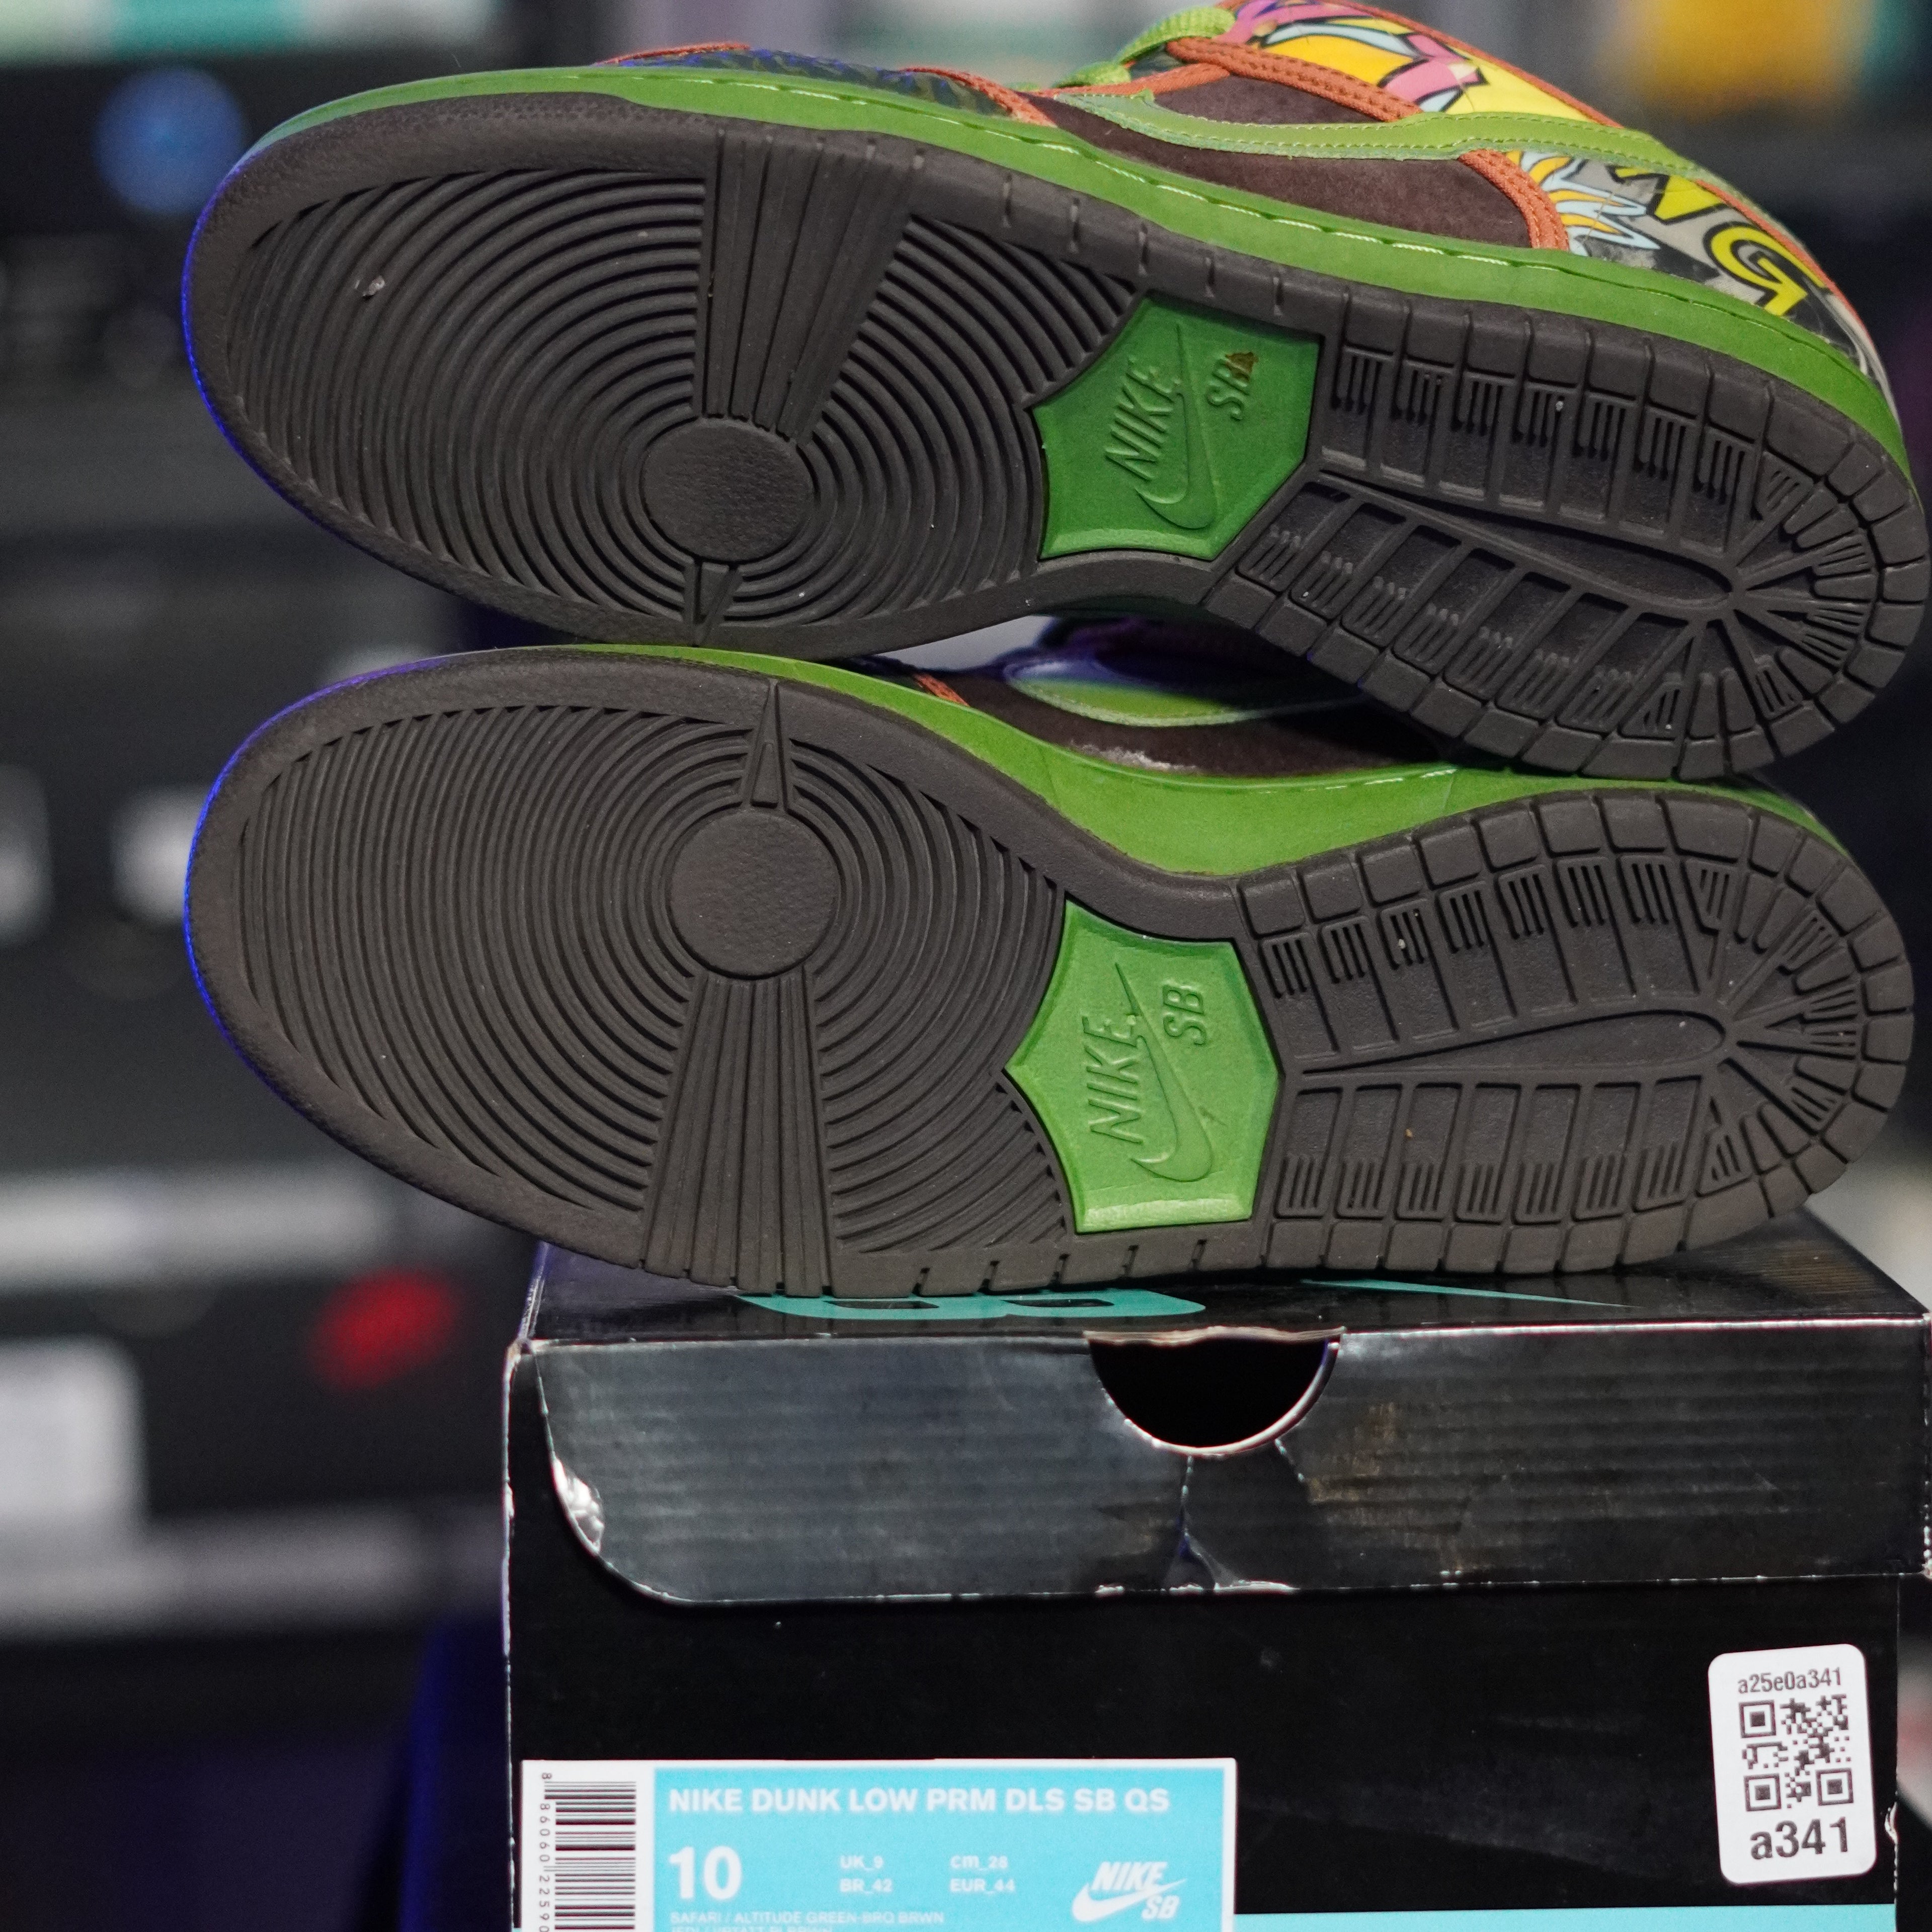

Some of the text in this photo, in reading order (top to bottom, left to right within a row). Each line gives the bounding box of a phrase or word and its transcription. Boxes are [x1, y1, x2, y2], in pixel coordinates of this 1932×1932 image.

[1105, 355, 1181, 482] NIKE
[1161, 984, 1207, 1046] SB
[1081, 1015, 1145, 1144] NIKE
[1738, 1667, 1842, 1694] a25e0a341
[669, 1788, 1170, 1812] NIKE DUNK LOW PRM DLS SB QS
[539, 1803, 551, 1863] 86060
[1750, 1817, 1849, 1860] a341
[668, 1845, 742, 1901] 10
[839, 1878, 893, 1894] BR_42
[950, 1878, 1016, 1894] EUR_44
[1091, 1861, 1168, 1890] NIKE
[734, 1912, 803, 1923] ALTITUDE
[1141, 1895, 1180, 1919] SB
